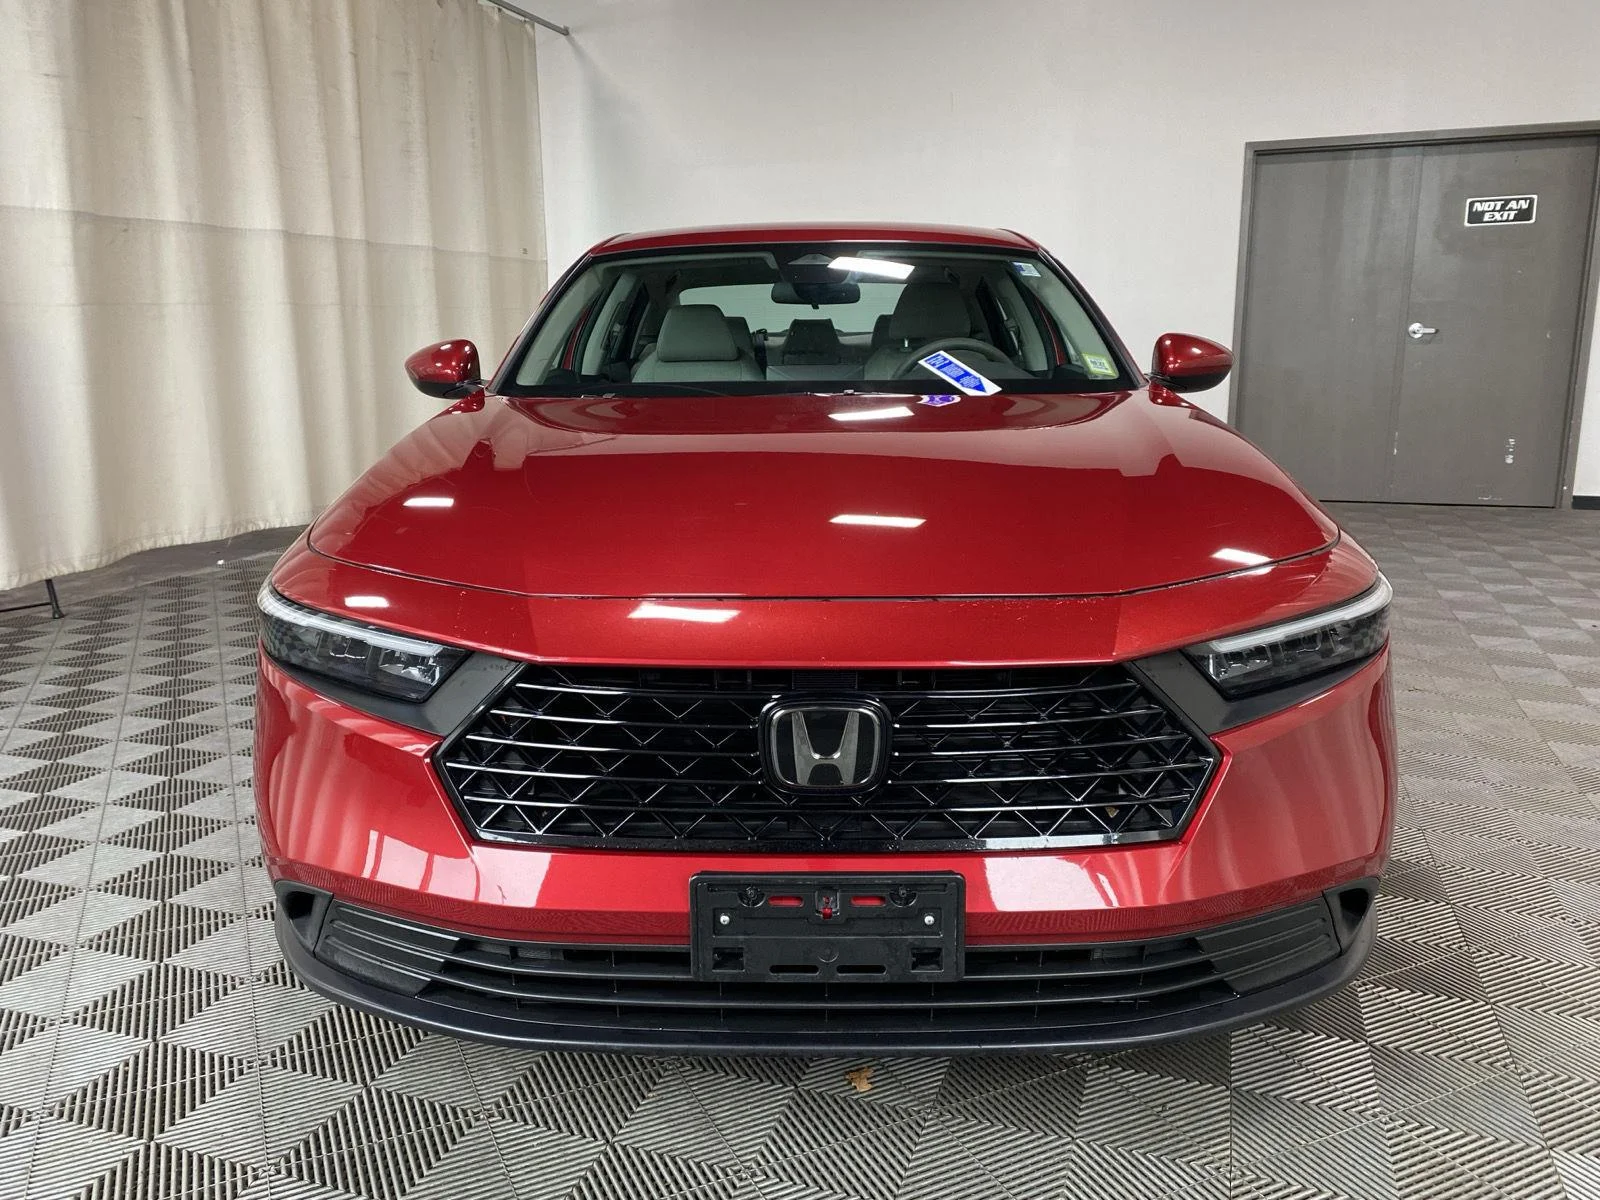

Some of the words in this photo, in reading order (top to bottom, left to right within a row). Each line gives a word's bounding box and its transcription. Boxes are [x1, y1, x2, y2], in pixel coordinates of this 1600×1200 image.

[1472, 201, 1504, 212] NOT
[1505, 199, 1530, 210] AN
[1483, 211, 1518, 221] EXIT
